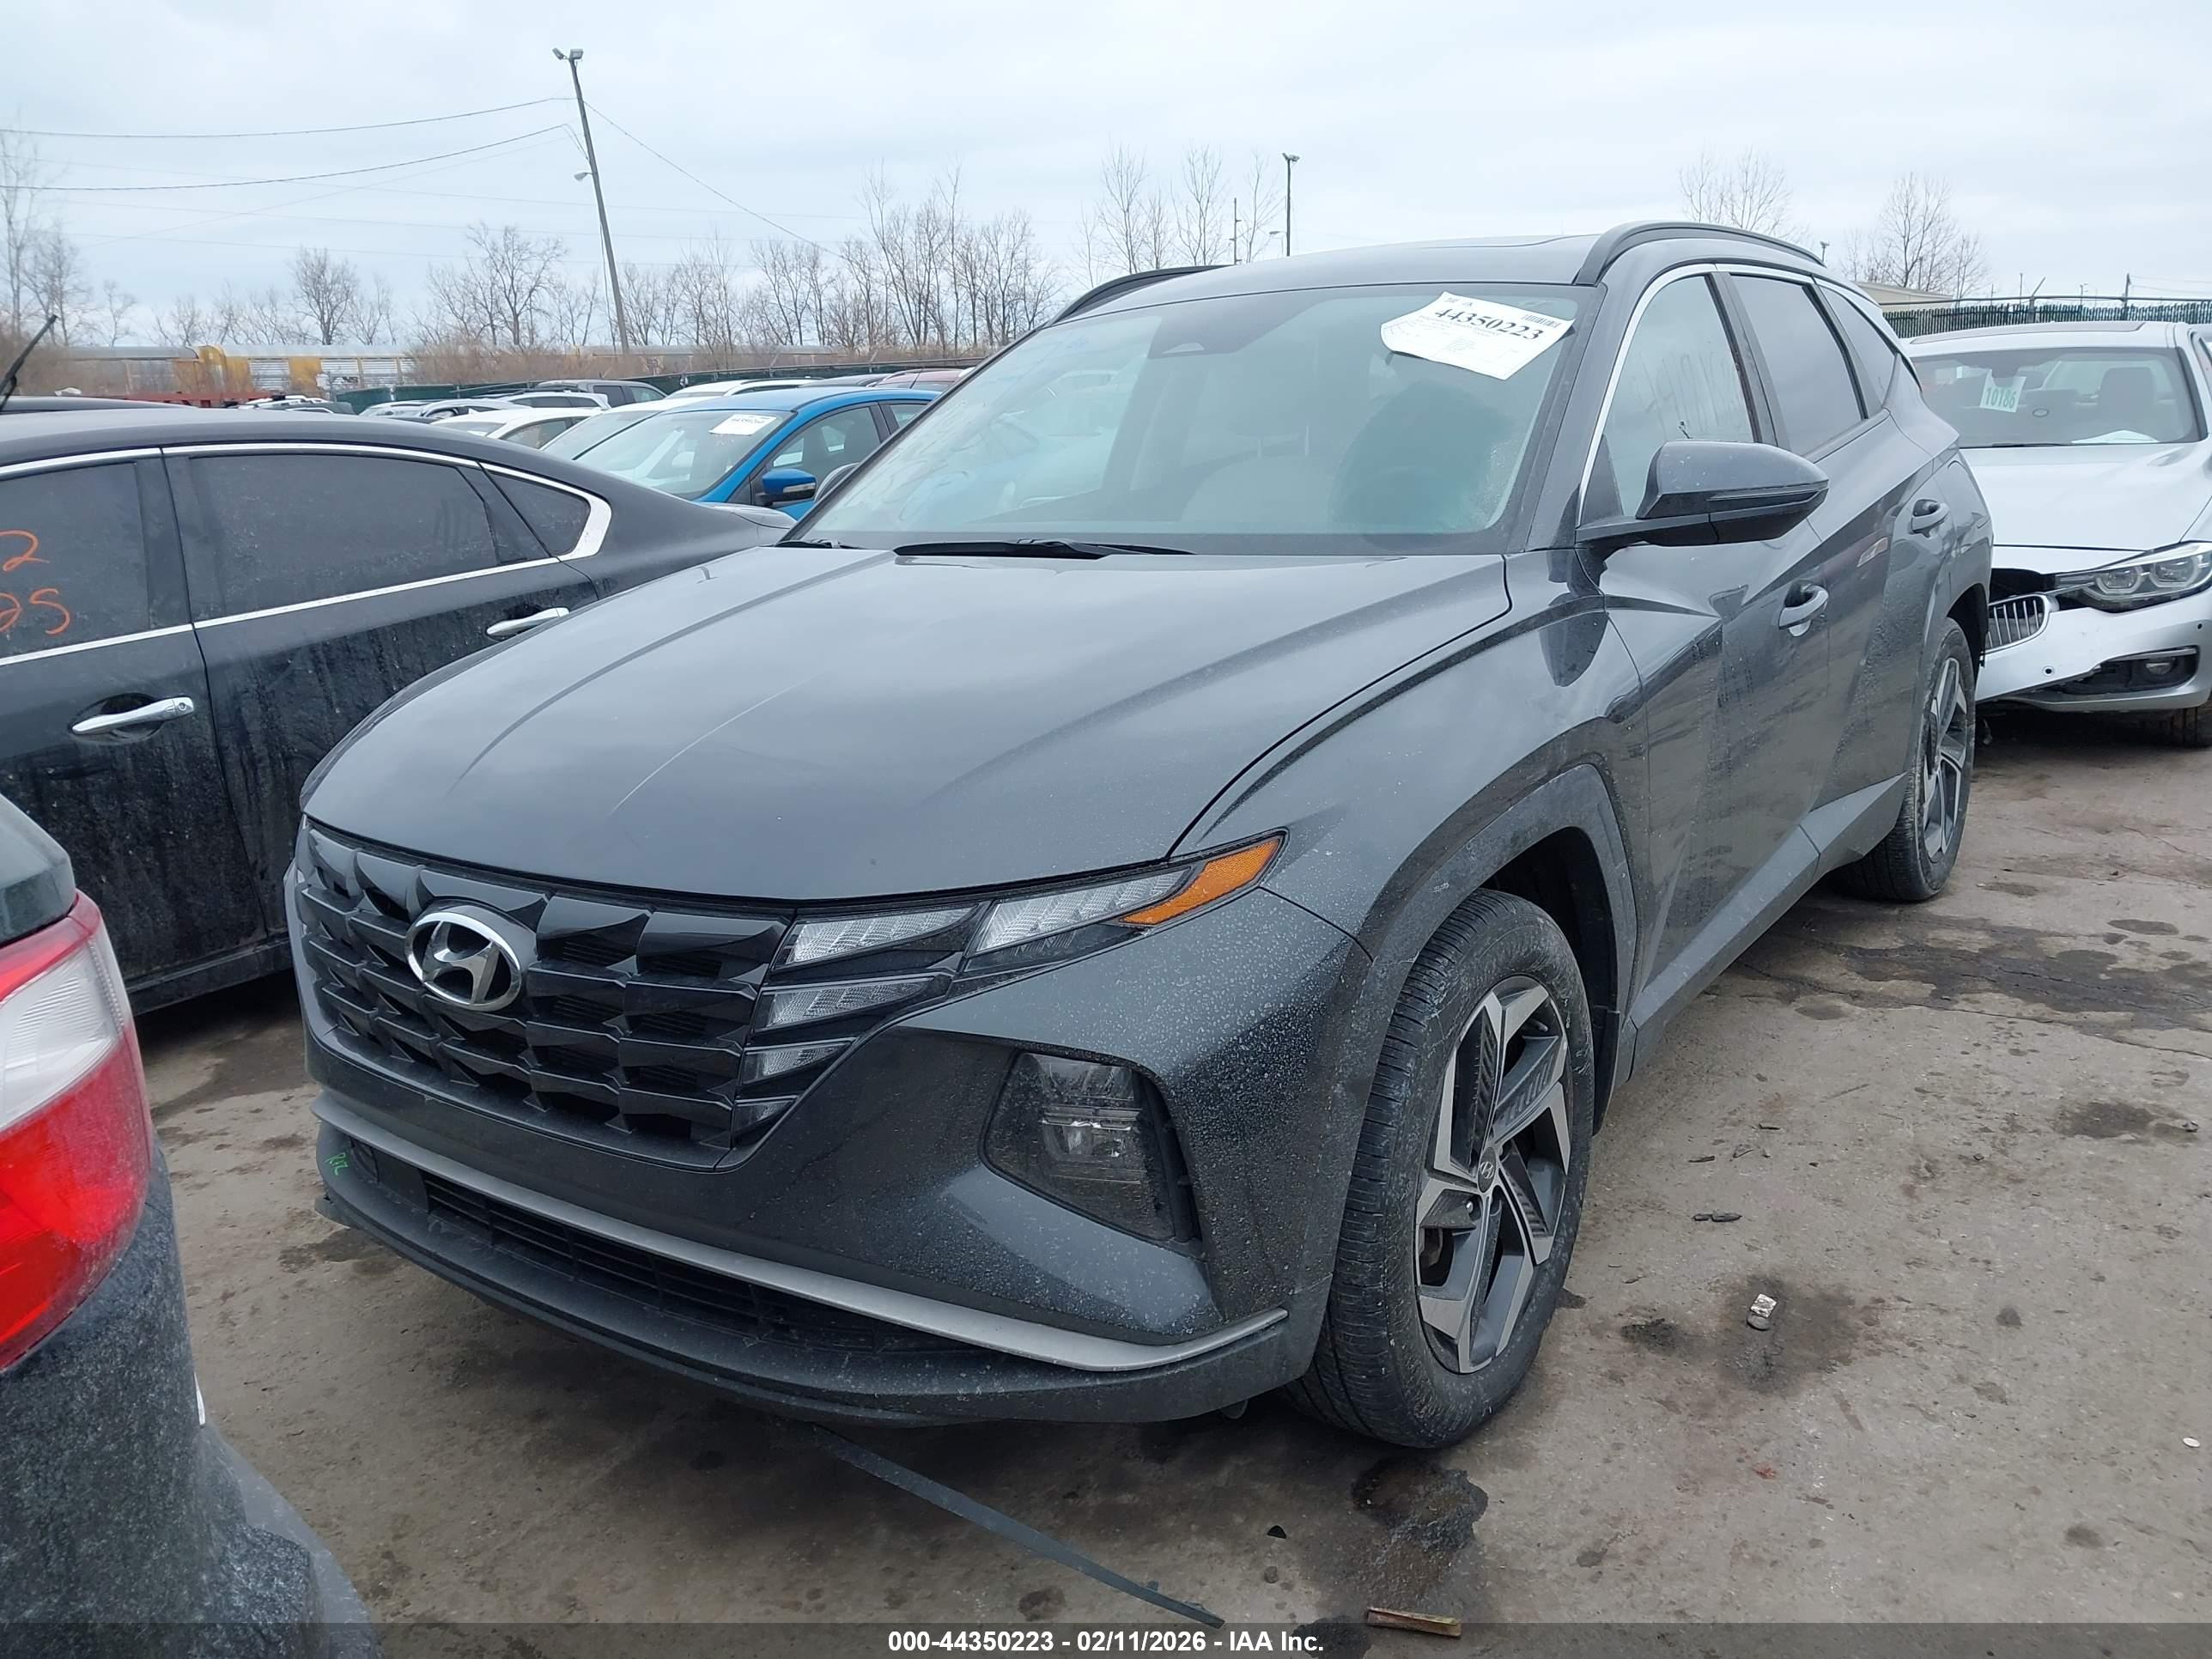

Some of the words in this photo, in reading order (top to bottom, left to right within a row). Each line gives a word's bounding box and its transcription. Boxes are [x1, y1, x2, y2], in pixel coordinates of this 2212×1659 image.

[1435, 308, 1544, 340] 44350223
[1985, 387, 2017, 408] 10186
[0, 529, 50, 573] 2
